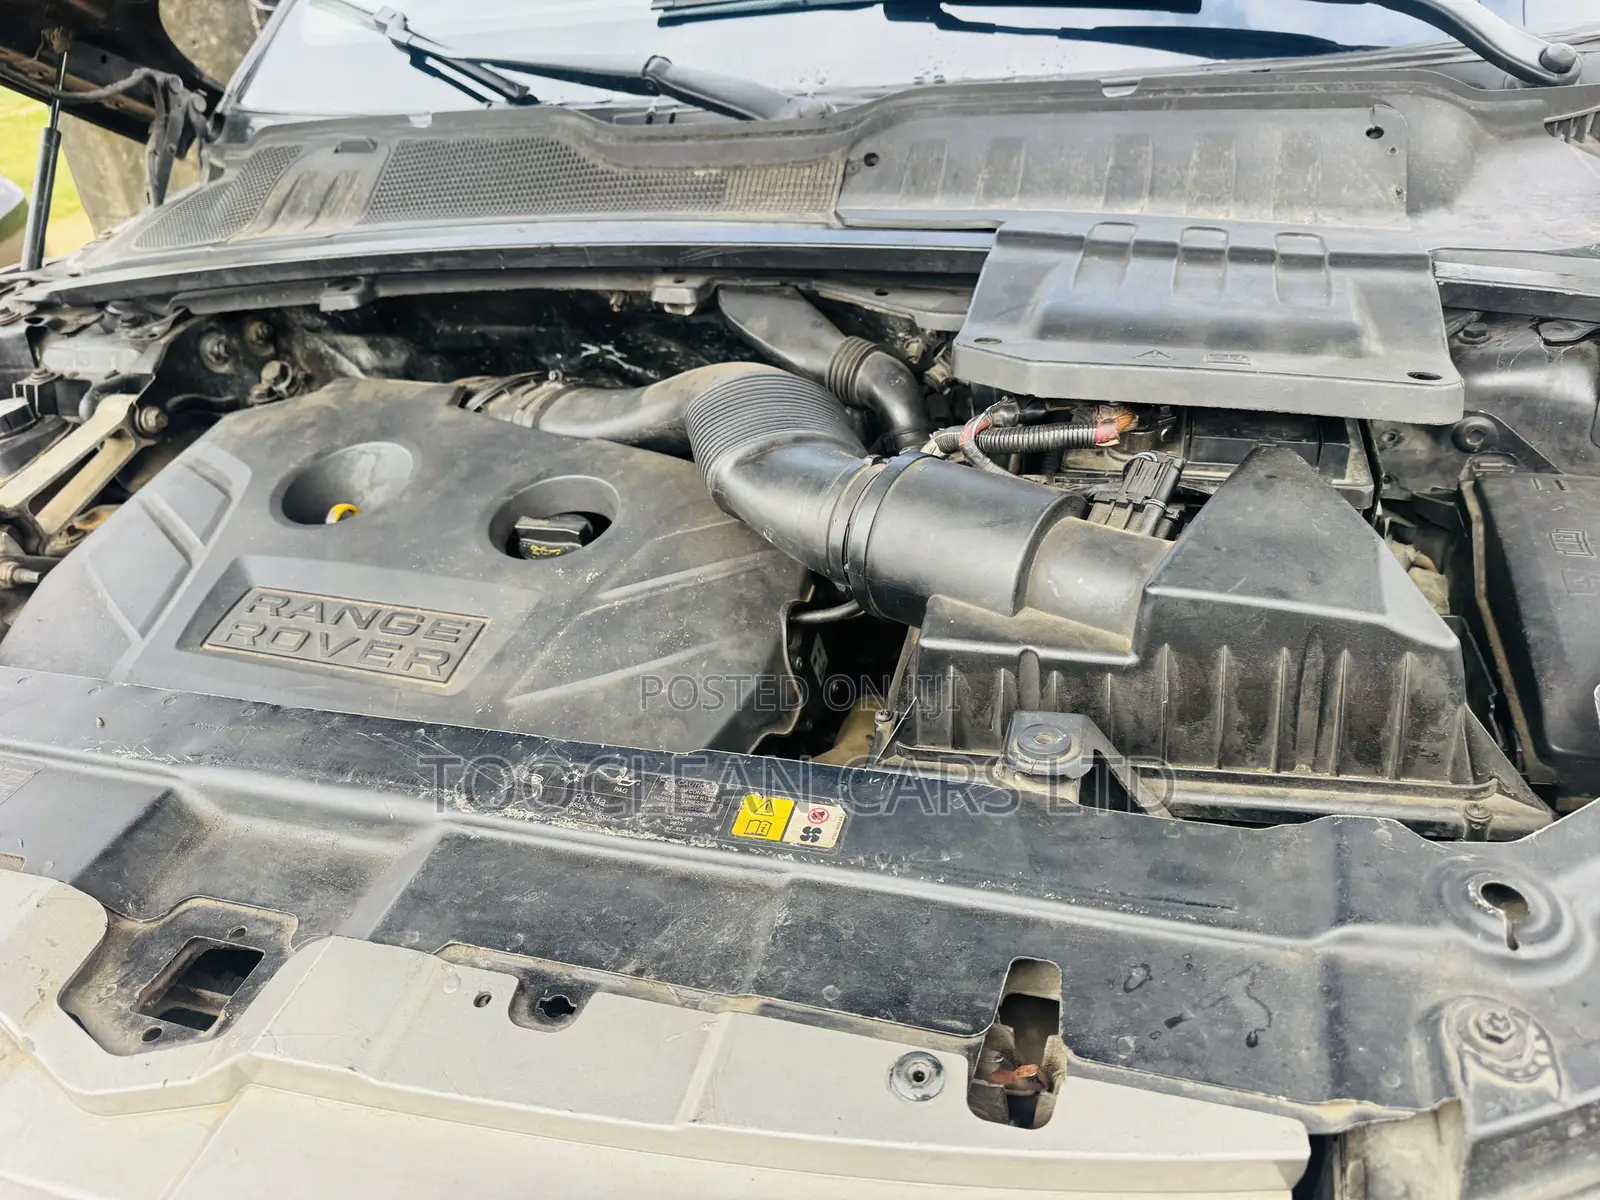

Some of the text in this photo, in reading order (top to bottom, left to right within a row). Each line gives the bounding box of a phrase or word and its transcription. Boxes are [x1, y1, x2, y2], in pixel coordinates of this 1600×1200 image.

[247, 594, 474, 643] RANGE
[221, 621, 451, 676] ROVER
[613, 786, 628, 794] PAG
